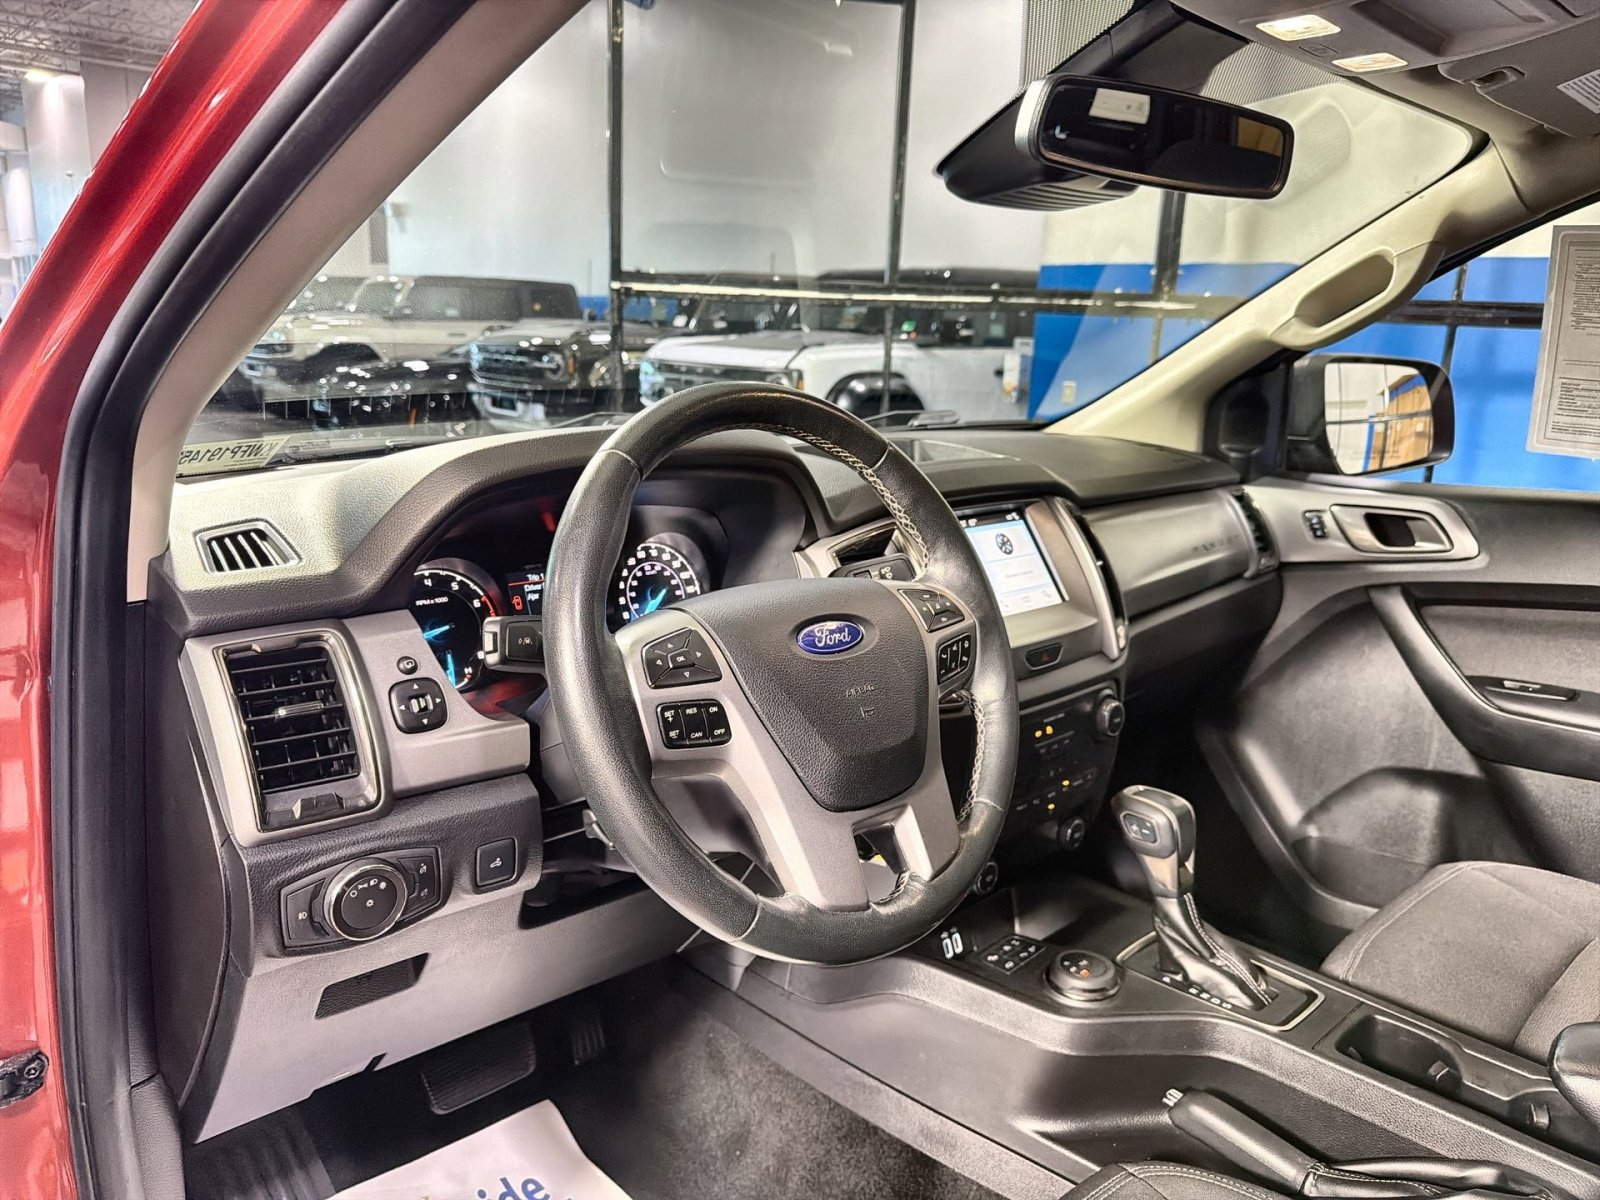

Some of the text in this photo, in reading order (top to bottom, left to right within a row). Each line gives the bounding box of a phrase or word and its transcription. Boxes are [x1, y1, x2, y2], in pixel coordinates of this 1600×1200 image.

[424, 578, 432, 586] 4
[451, 582, 459, 590] 5
[473, 599, 481, 607] 6
[814, 627, 851, 646] Ford
[664, 710, 675, 718] SET
[685, 707, 697, 715] RES
[690, 731, 703, 739] CAN
[714, 728, 726, 736] OFF
